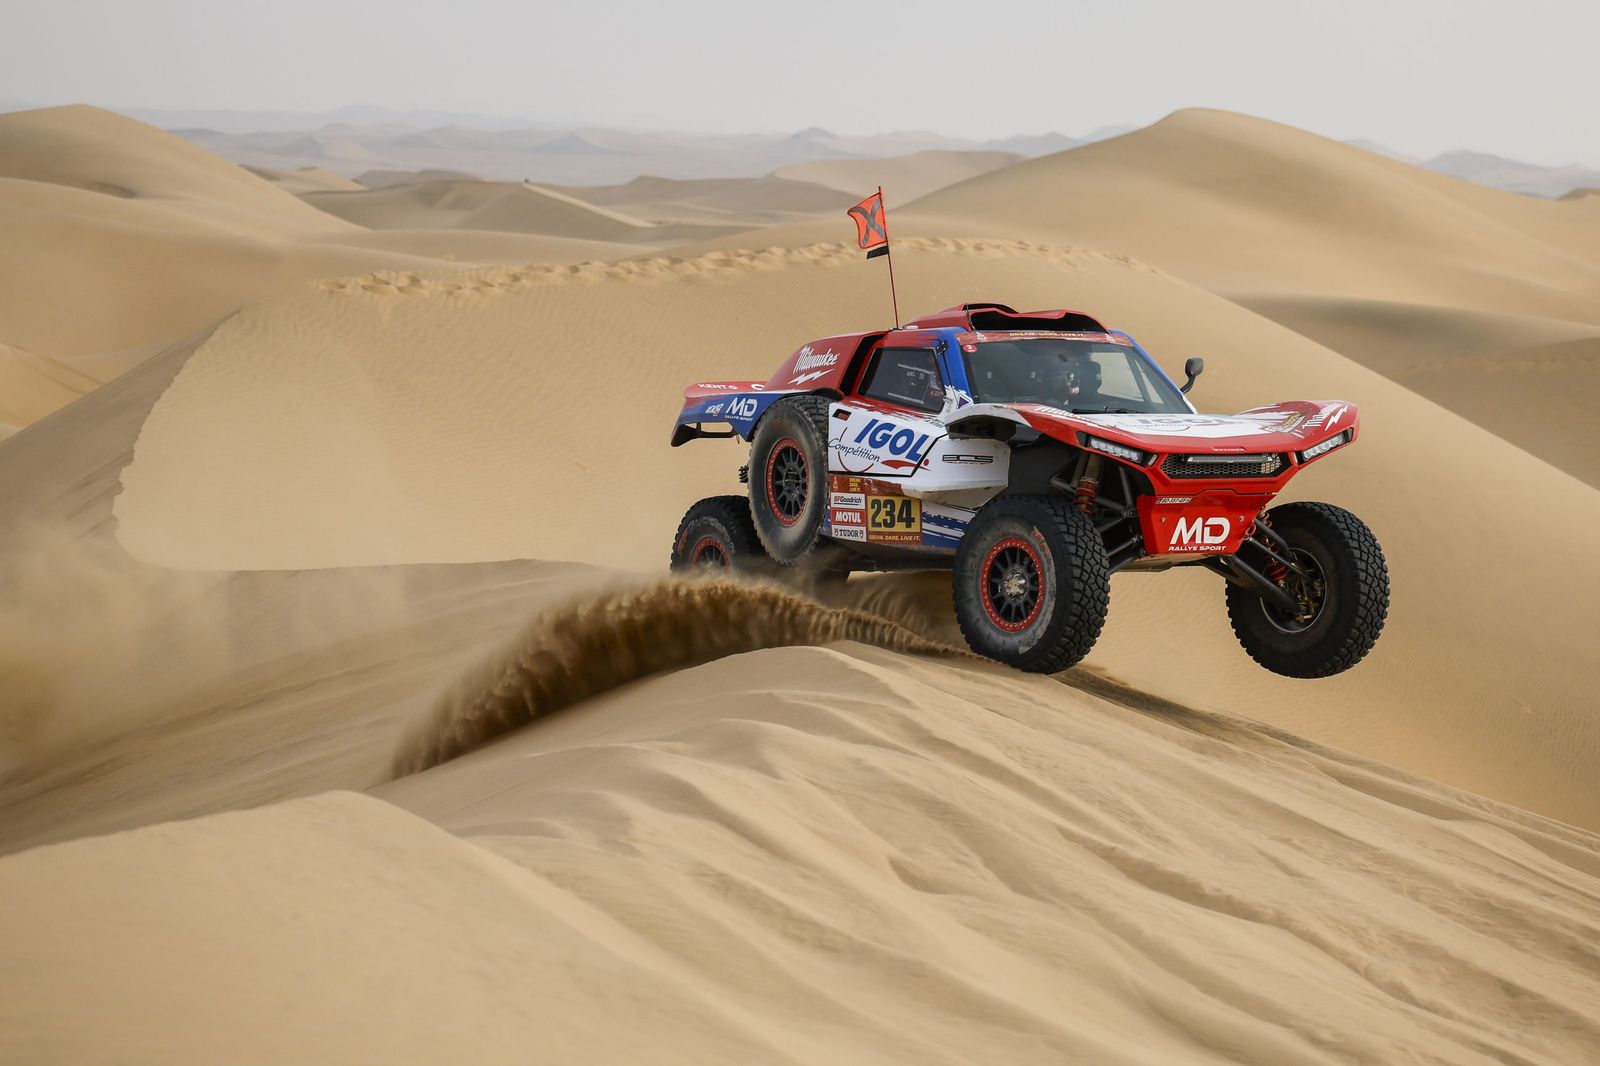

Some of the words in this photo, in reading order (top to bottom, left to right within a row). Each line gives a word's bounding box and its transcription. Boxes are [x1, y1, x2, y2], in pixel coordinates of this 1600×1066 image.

[793, 345, 840, 374] Milwaukee
[726, 397, 758, 417] MD
[828, 437, 880, 463] Compétition
[854, 418, 929, 461] IGOL
[833, 495, 862, 504] BFGoodrich
[835, 511, 862, 523] MOTUL
[870, 498, 915, 529] 234
[839, 529, 859, 538] TUDOR
[1169, 516, 1231, 545] MD
